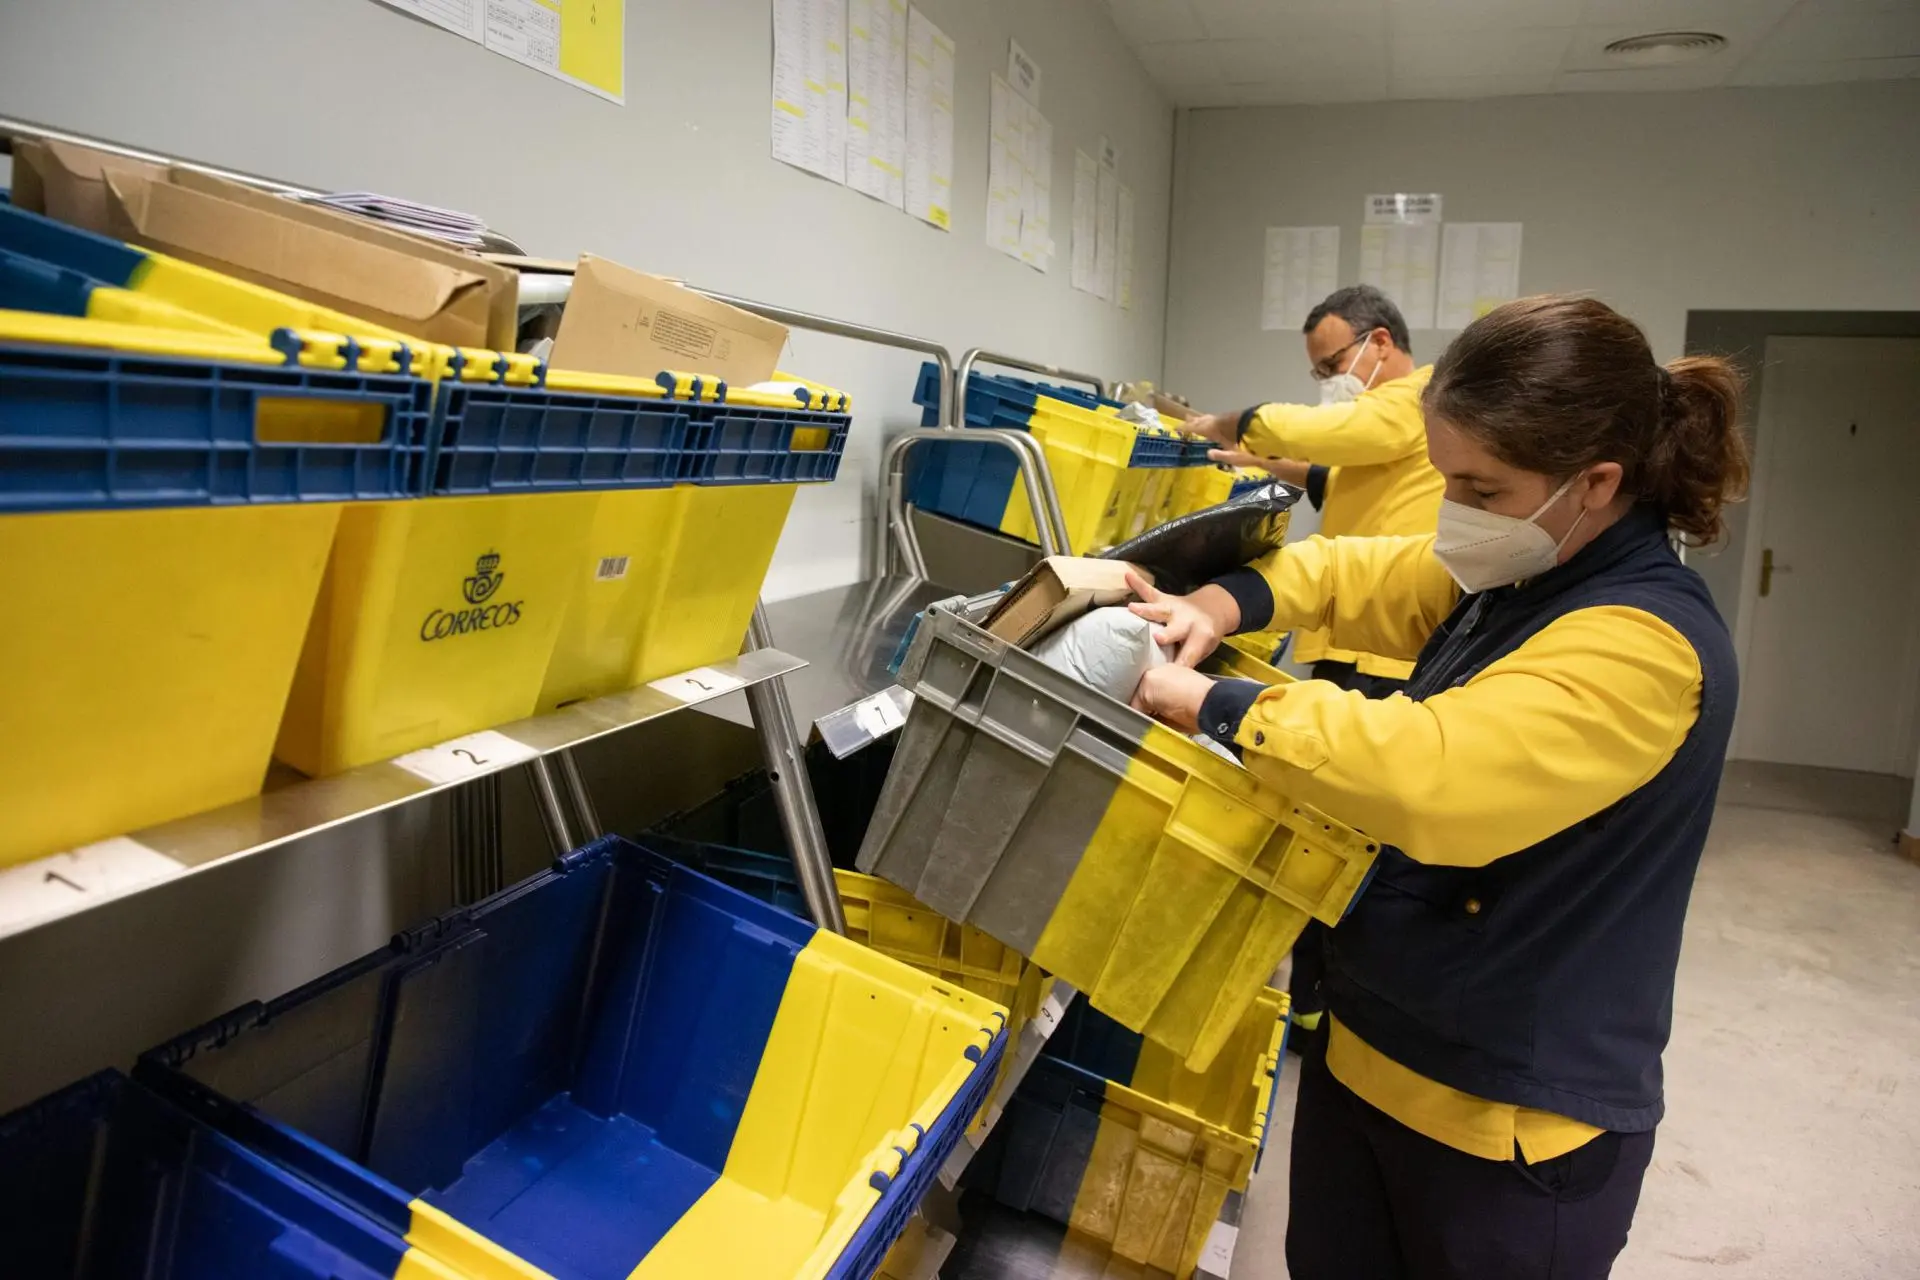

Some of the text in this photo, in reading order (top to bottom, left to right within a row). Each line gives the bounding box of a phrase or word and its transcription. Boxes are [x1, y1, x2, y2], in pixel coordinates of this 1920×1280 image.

[420, 600, 524, 642] CORREOS
[684, 678, 713, 691] 2
[451, 748, 490, 766] 2
[44, 869, 87, 893] 1
